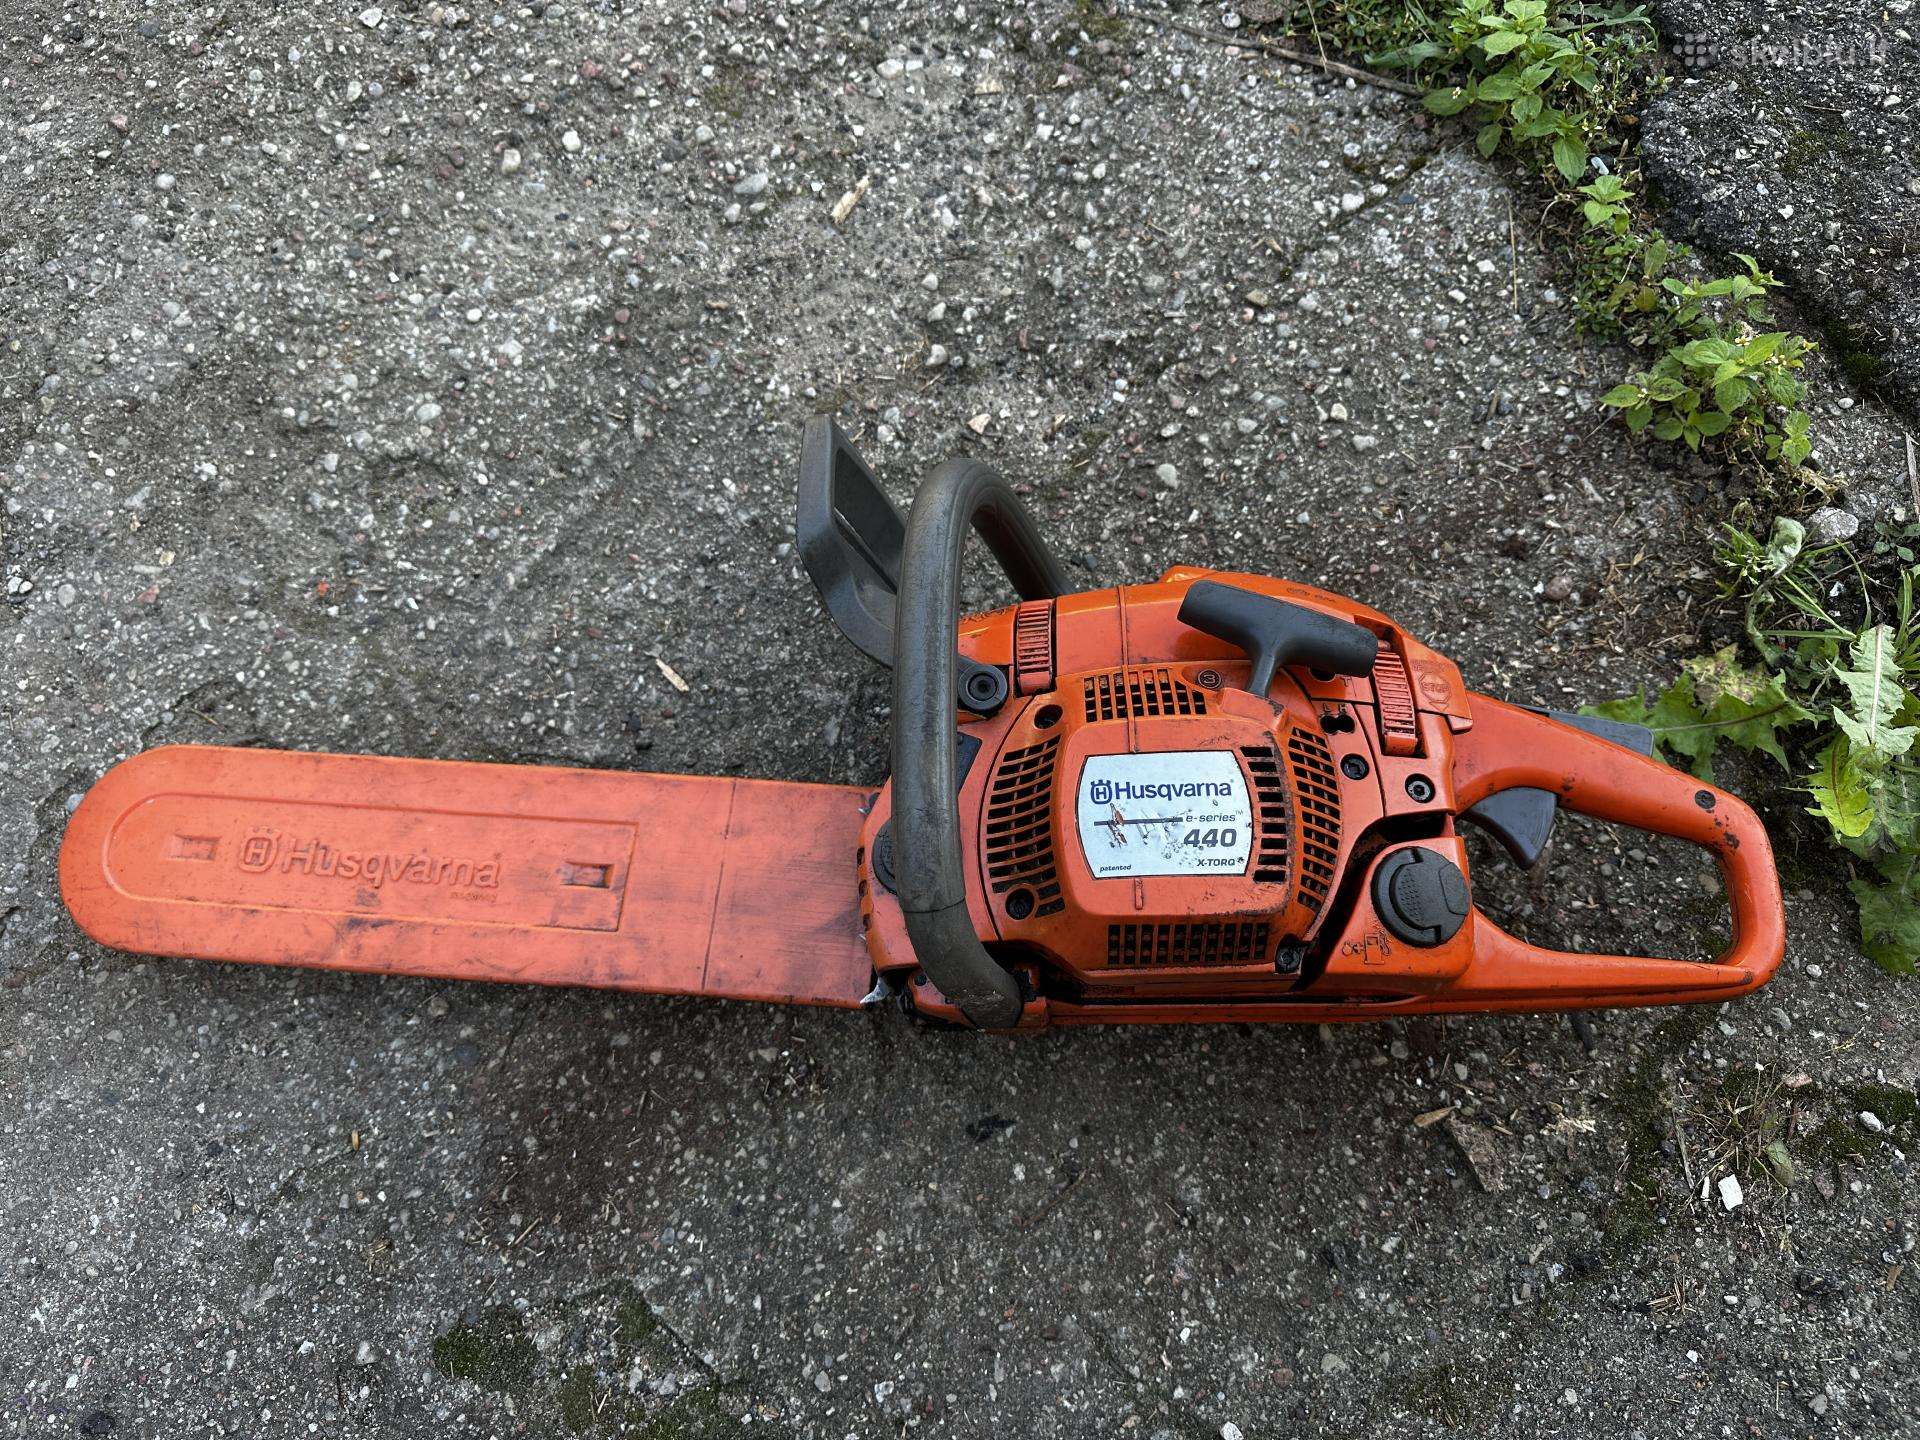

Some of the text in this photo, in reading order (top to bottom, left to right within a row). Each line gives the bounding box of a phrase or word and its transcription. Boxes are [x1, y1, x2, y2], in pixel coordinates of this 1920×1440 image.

[1338, 703, 1347, 713] H
[1115, 781, 1232, 801] Husqvarna
[1184, 828, 1237, 847] 440
[281, 836, 500, 889] Husqvarna
[1100, 864, 1132, 873] patented
[1197, 858, 1235, 867] X-TORQ
